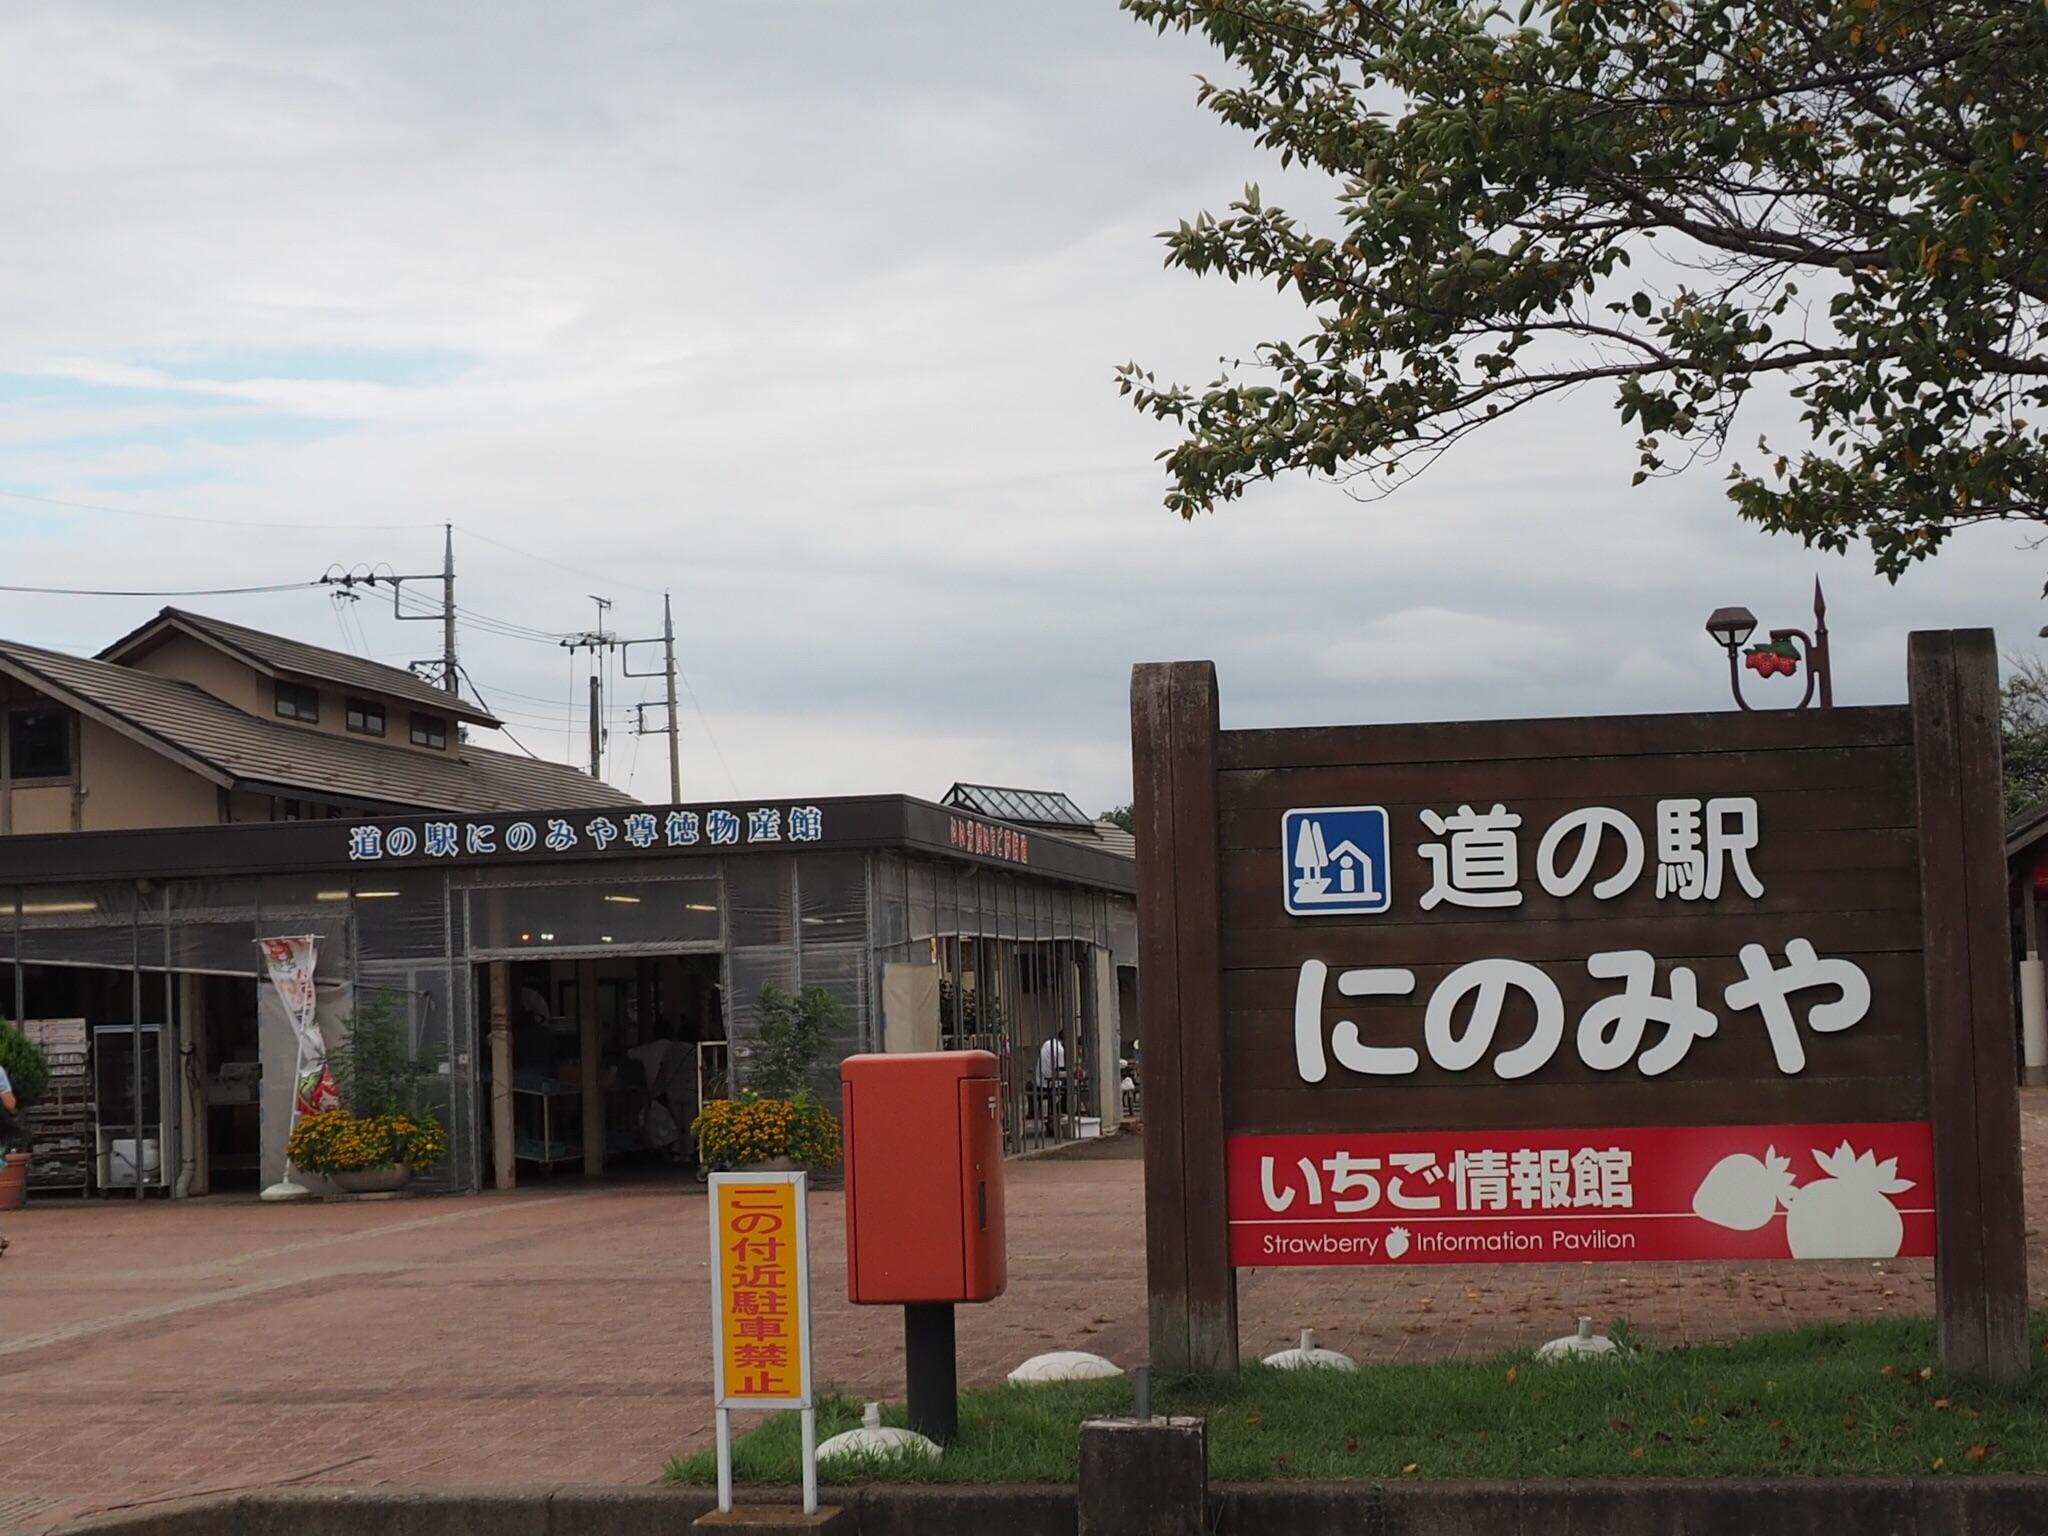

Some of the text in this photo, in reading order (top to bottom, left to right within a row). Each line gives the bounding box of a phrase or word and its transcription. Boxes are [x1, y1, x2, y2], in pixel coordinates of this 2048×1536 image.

[348, 806, 824, 860] 道の駅にのみや尊徳物産館
[1416, 796, 1766, 911] 道の駅
[1294, 937, 1872, 1083] にのみや
[1260, 1146, 1633, 1213] いちご情報館
[1263, 1229, 1636, 1257] Strawberry Information Pavilion
[730, 1189, 791, 1395] この付近駐車禁止
